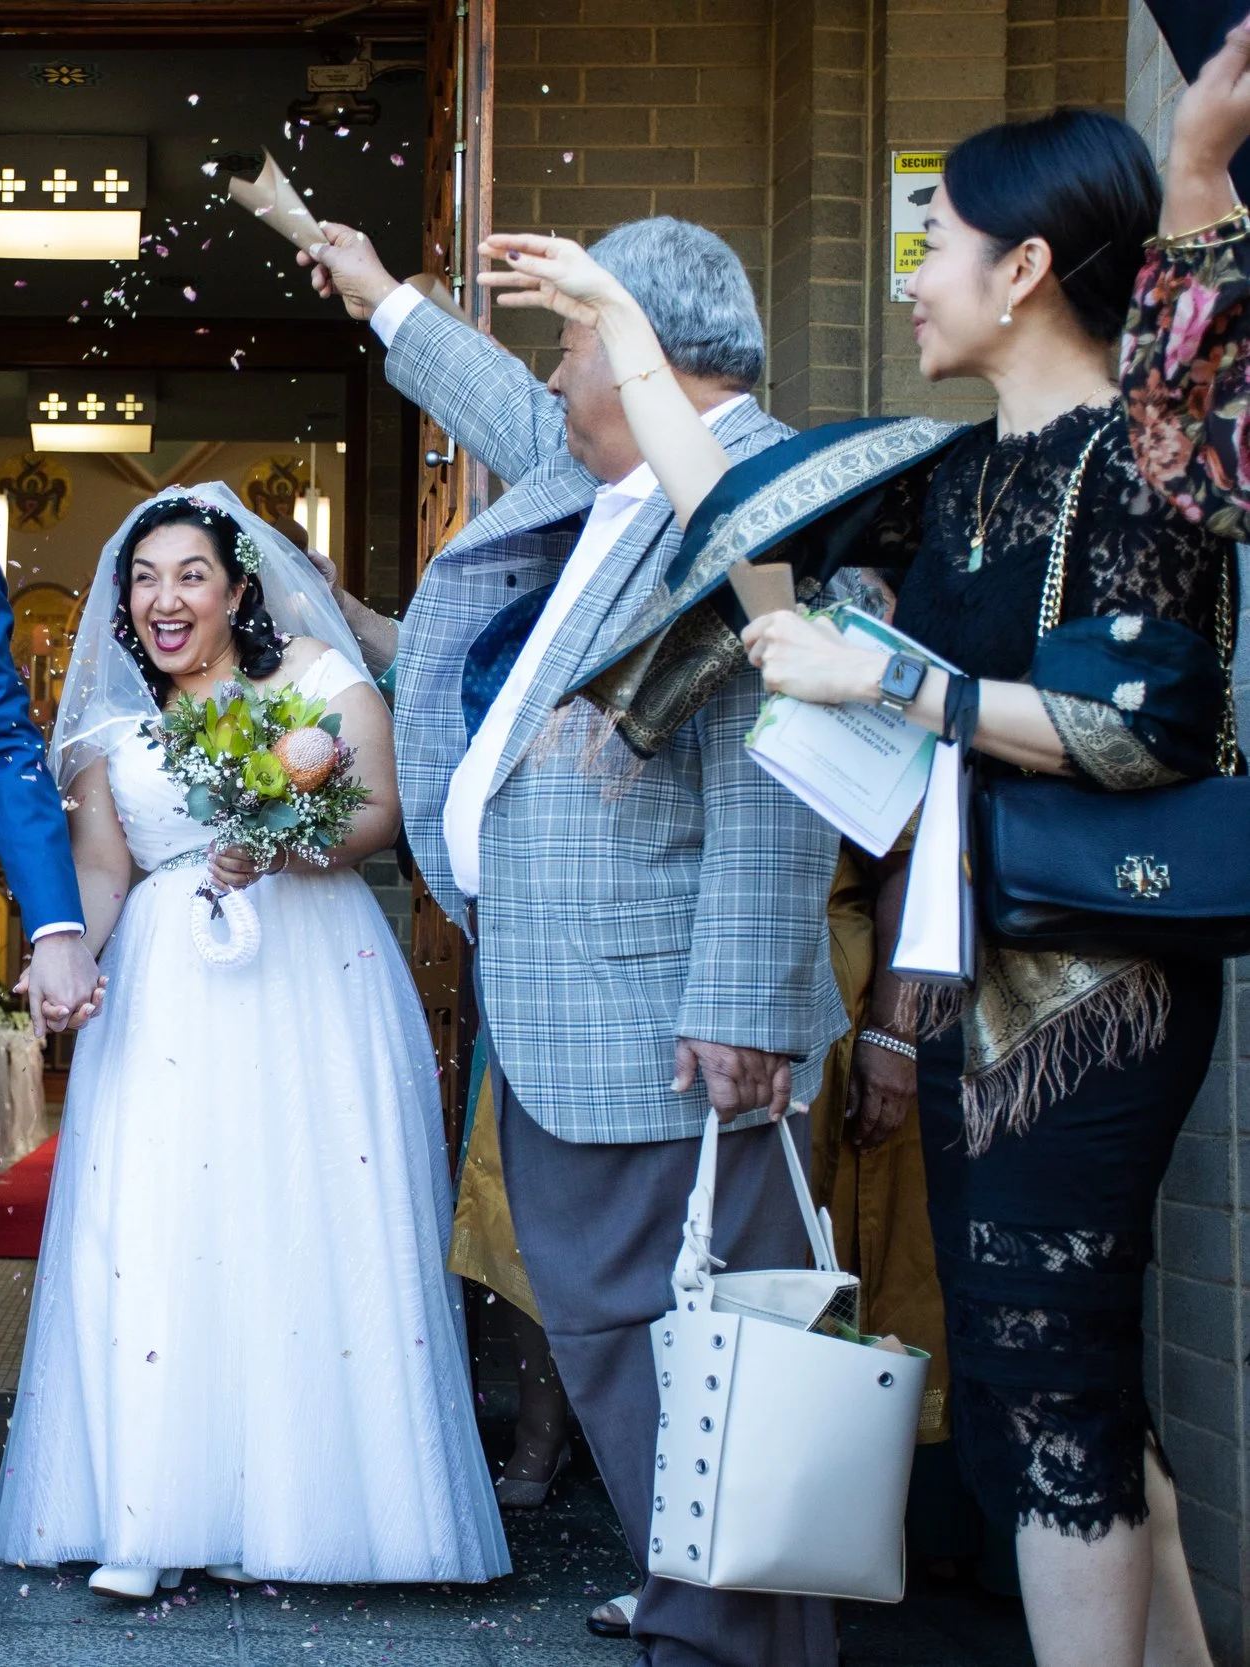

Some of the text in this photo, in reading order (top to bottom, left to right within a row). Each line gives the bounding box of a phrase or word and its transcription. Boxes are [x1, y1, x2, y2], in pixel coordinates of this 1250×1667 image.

[901, 158, 943, 168] SECURIT
[903, 249, 917, 257] ARE
[899, 259, 909, 267] 24
